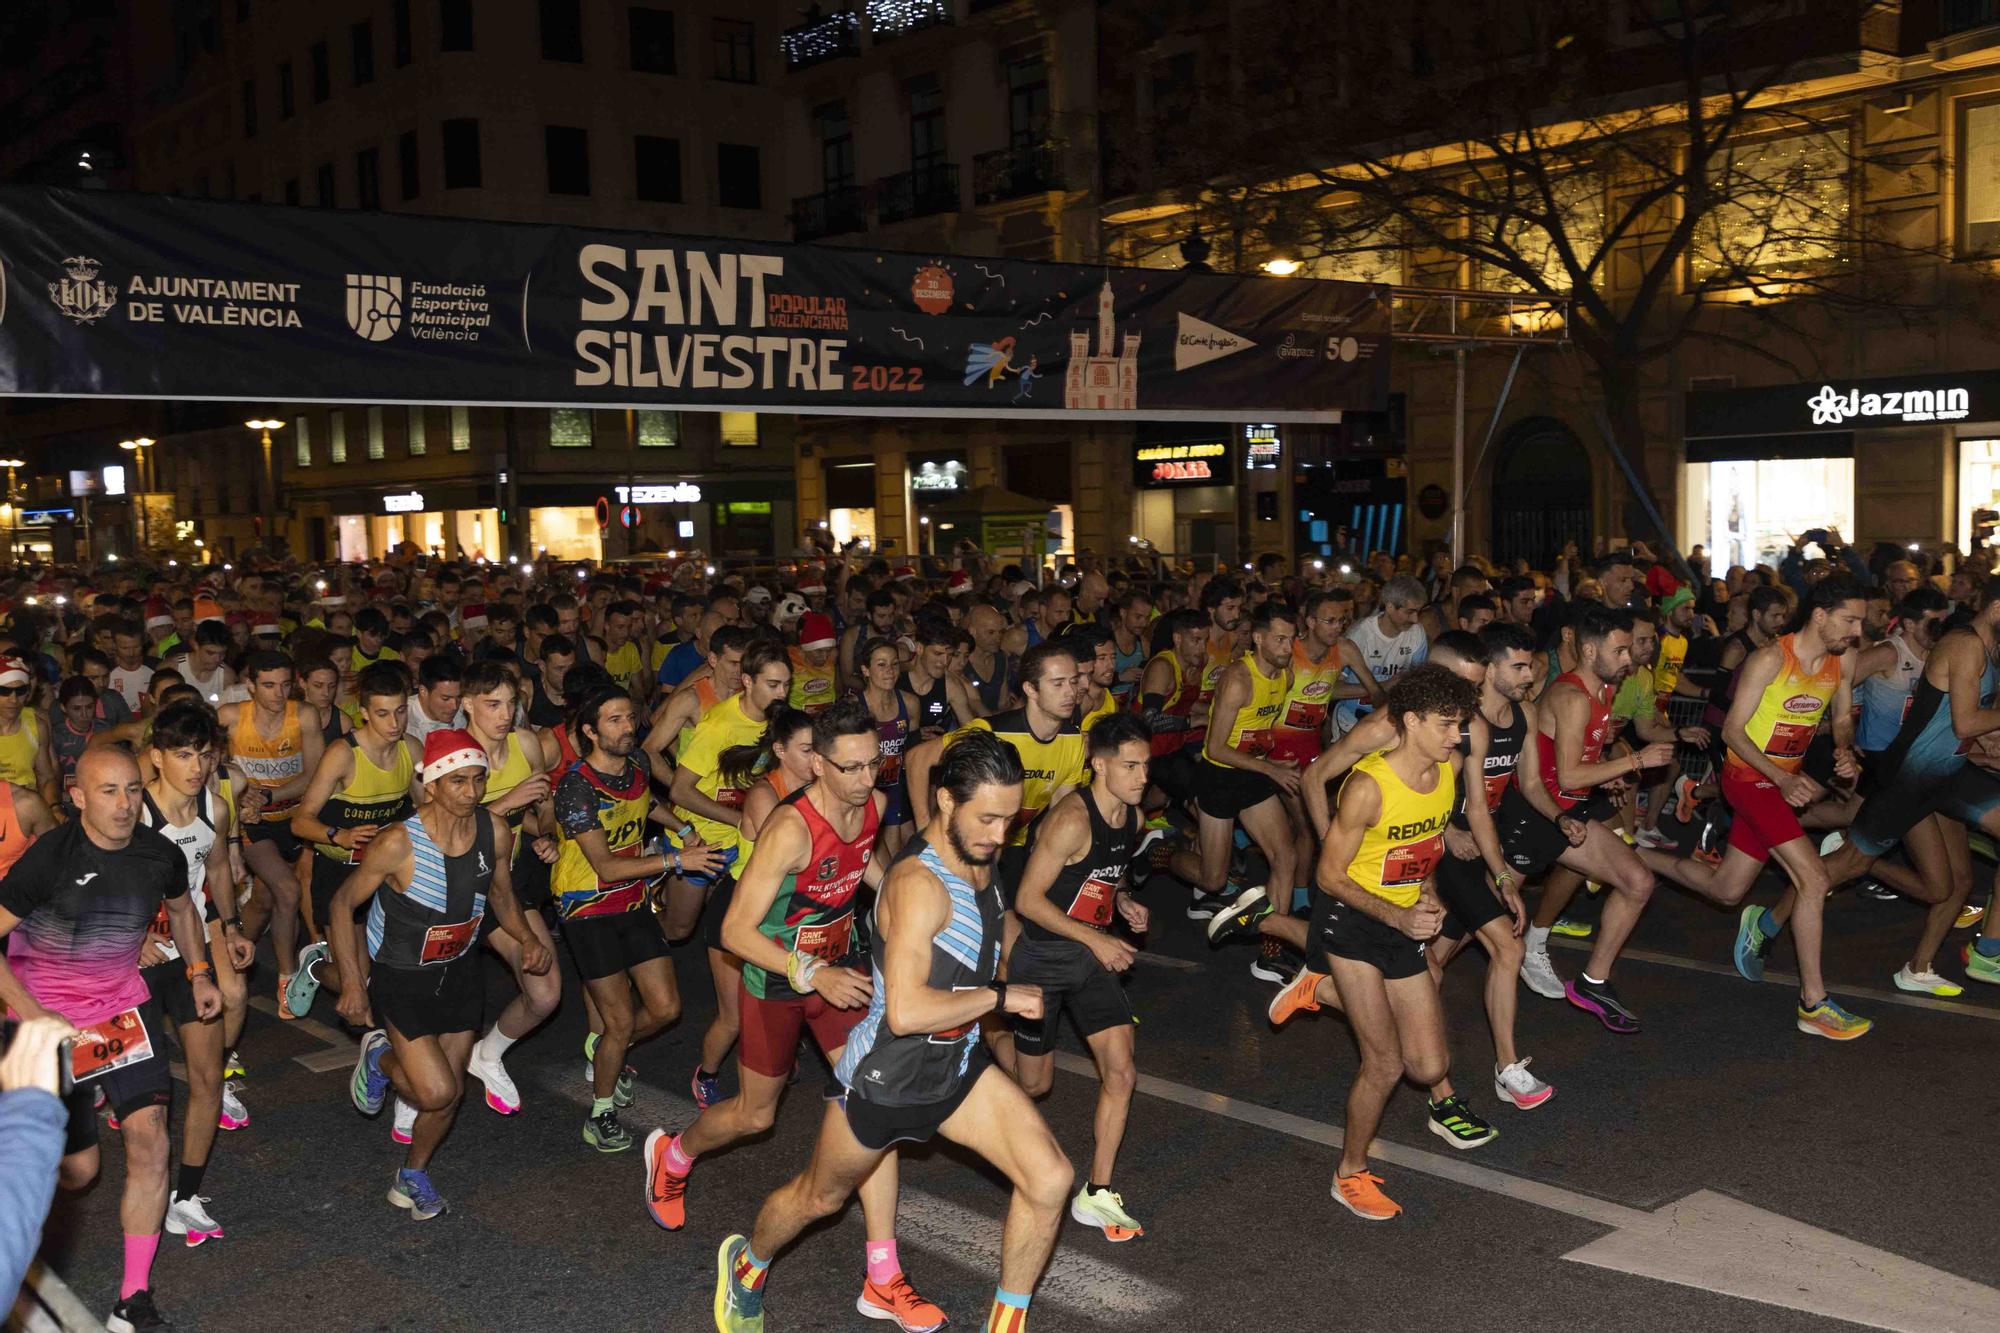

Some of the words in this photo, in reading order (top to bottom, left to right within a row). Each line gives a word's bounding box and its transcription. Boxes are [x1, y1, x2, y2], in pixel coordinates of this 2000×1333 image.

[128, 275, 300, 303] AJUNTAMENT
[411, 281, 486, 297] Fundació
[579, 244, 784, 328] SANT
[411, 296, 489, 312] Esportiva
[769, 293, 846, 315] POPULAR
[129, 302, 165, 322] DE
[173, 301, 303, 328] VALÈNCIA
[411, 311, 491, 328] Municipal
[411, 326, 479, 341] València
[1180, 335, 1188, 346] El
[1189, 335, 1208, 347] Corte
[852, 364, 925, 392] 2022
[1257, 704, 1282, 717] REDOLA
[1787, 700, 1820, 710] Serrano
[1484, 753, 1519, 769] EDOLA
[1024, 769, 1057, 780] EDOLAT
[1400, 857, 1432, 878] 157
[801, 931, 823, 939] SANT
[94, 1038, 125, 1061] 99
